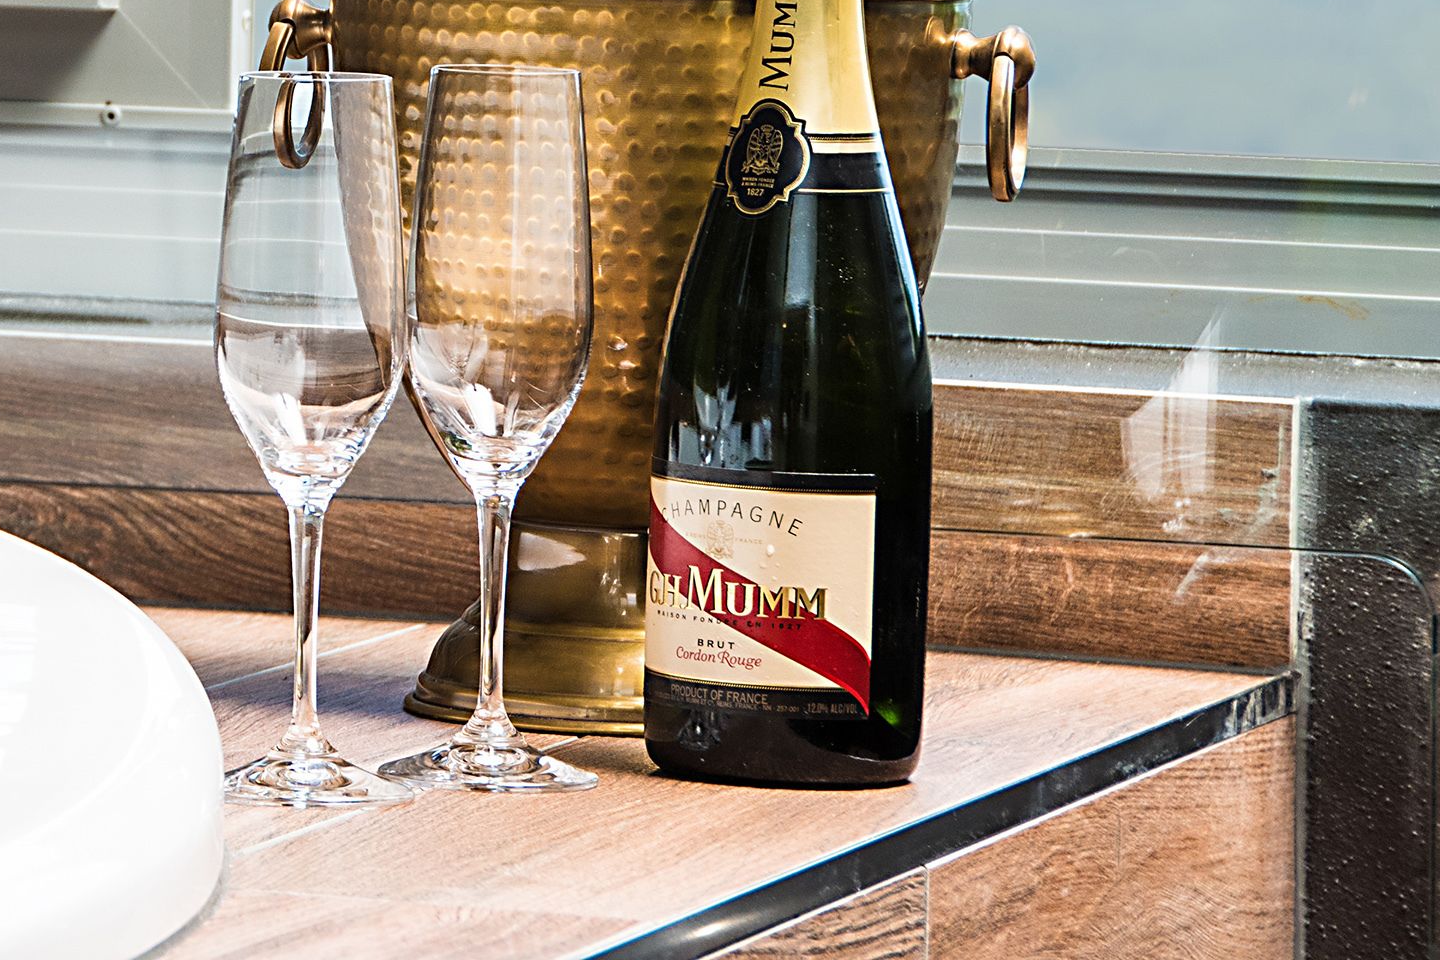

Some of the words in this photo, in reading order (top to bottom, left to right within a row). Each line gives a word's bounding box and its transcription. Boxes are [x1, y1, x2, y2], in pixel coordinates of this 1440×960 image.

[662, 499, 804, 537] CHAMPAGNE
[697, 638, 736, 650] BRUT
[675, 646, 717, 664] Cordon
[717, 650, 762, 671] Rouge
[671, 683, 709, 700] PRODUCT
[710, 688, 725, 701] OF
[726, 690, 770, 706] FRANCE
